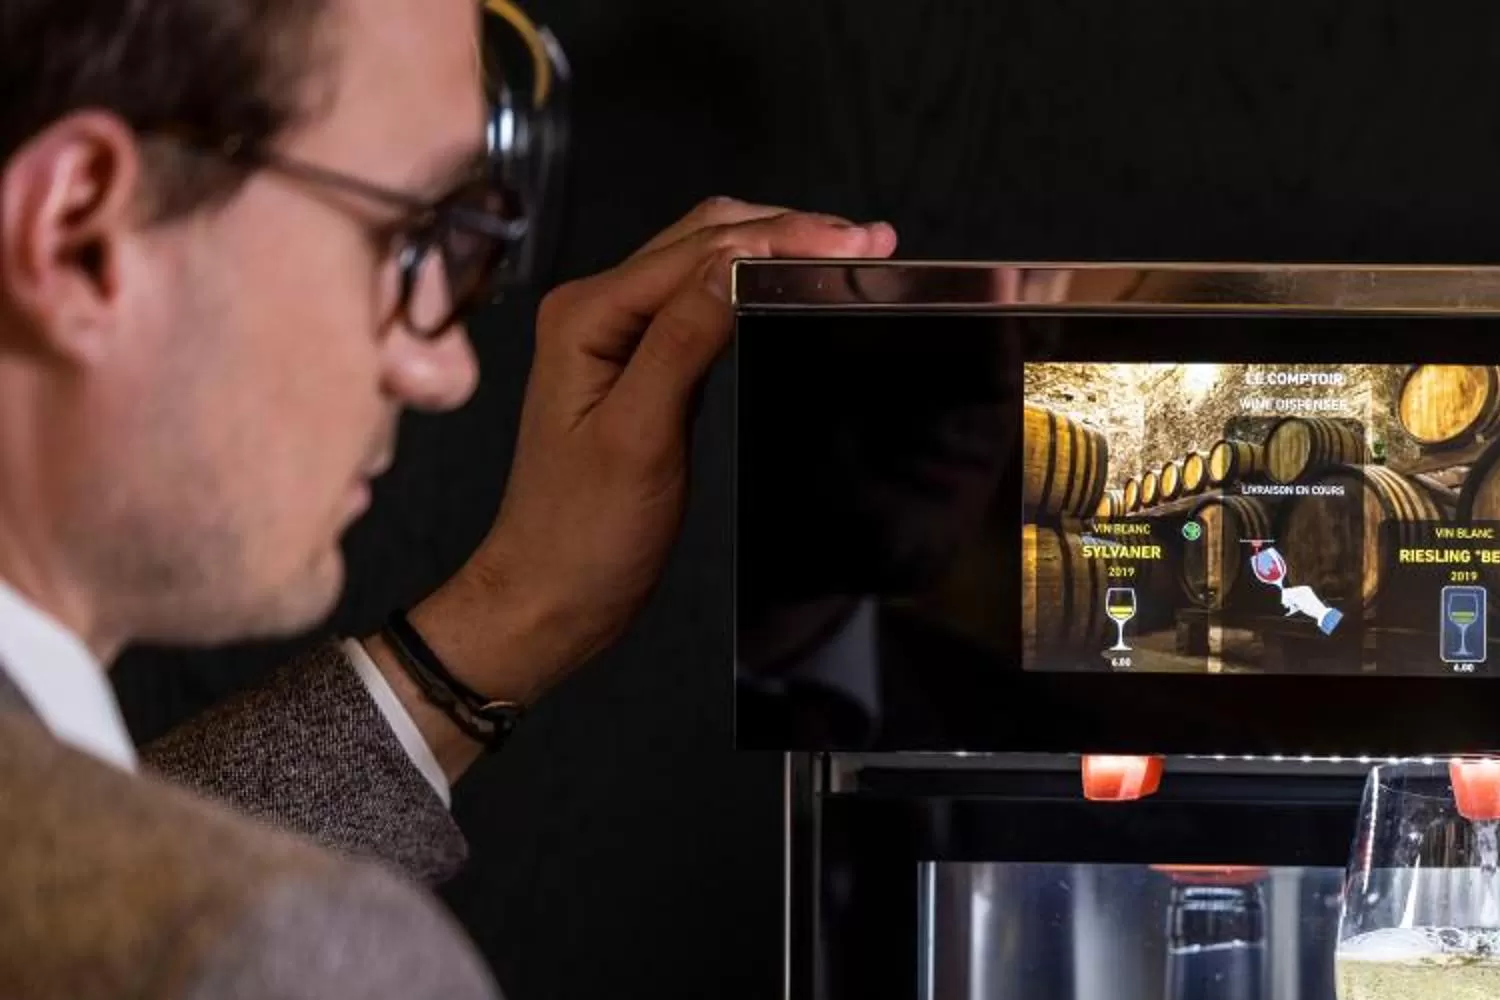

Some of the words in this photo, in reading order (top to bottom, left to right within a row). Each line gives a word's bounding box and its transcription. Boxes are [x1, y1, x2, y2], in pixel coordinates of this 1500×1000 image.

[1245, 372, 1264, 385] LE
[1267, 372, 1345, 386] COMPTOIR
[1241, 484, 1293, 496] LIVRAISON
[1295, 485, 1309, 496] EN
[1311, 485, 1345, 496] COURS
[1094, 523, 1111, 535] VIN
[1113, 523, 1151, 535] BLANC
[1435, 527, 1454, 538] VIN
[1457, 527, 1495, 540] BLANC
[1082, 545, 1162, 559] SYLVANER
[1400, 549, 1472, 563] RIESLING
[1107, 567, 1135, 577] 2019
[1450, 571, 1479, 582] 2019
